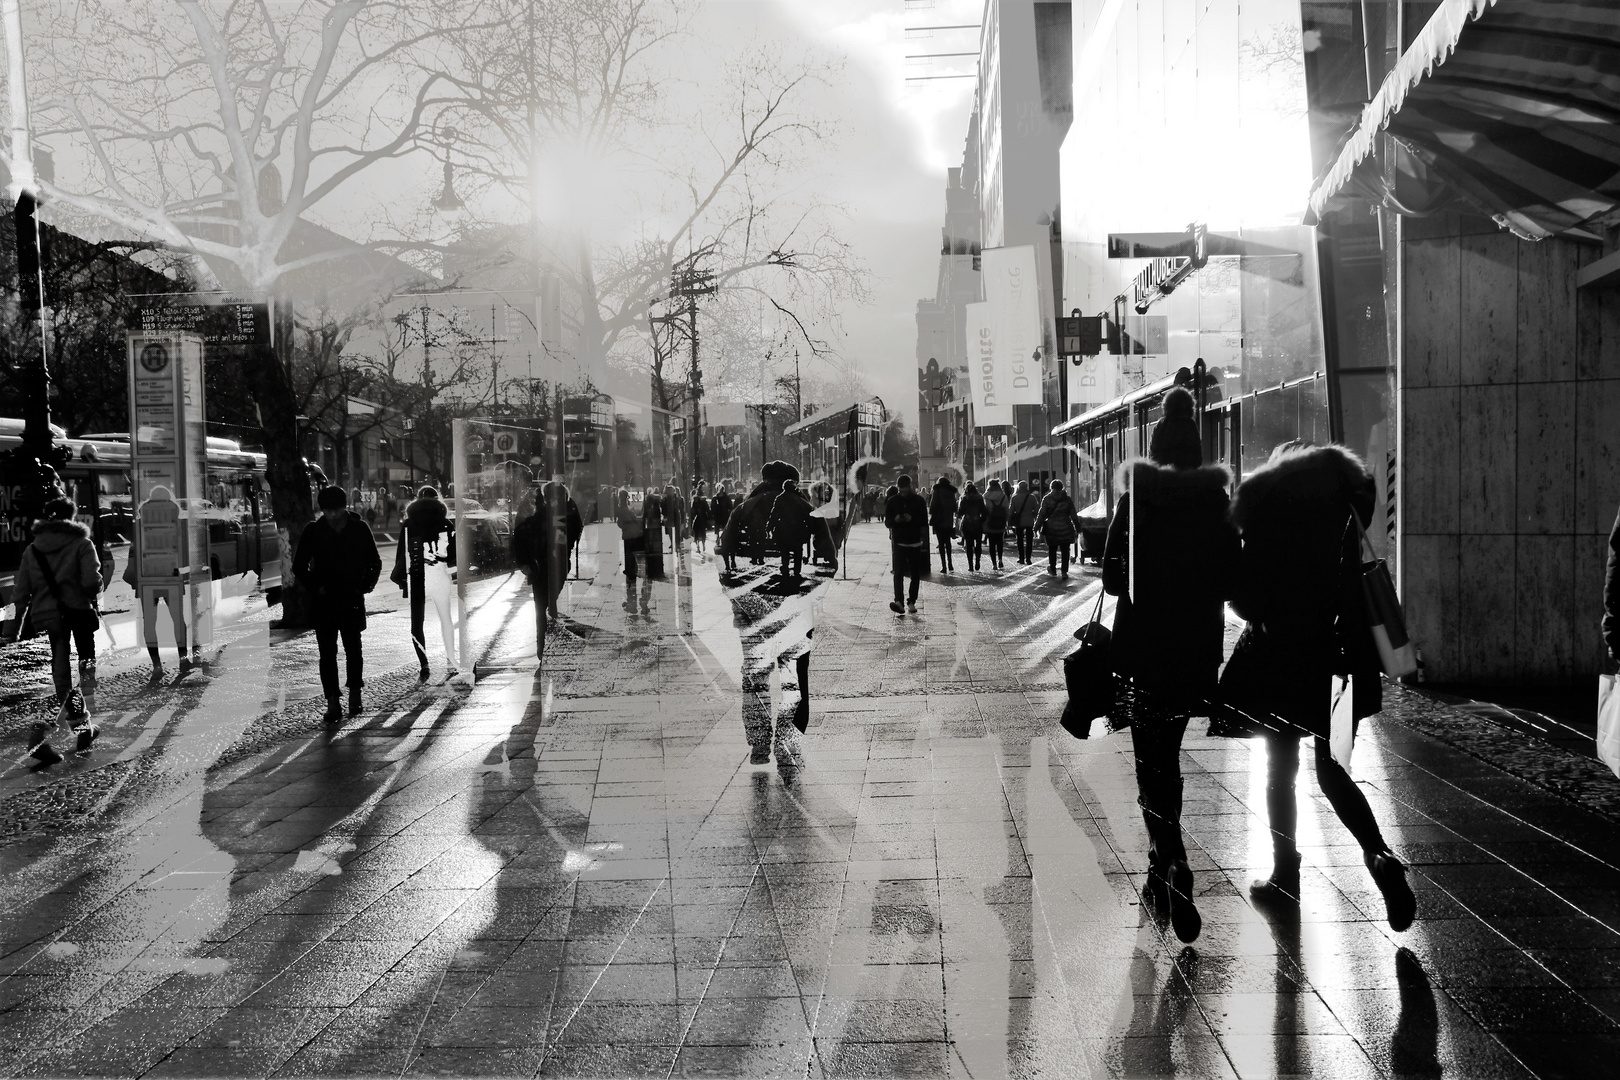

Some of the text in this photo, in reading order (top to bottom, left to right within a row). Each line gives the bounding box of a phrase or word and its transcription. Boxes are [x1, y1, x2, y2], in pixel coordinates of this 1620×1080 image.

[141, 308, 155, 316] X10
[241, 304, 254, 312] min
[142, 315, 155, 323] 109
[236, 312, 242, 320] 5
[142, 322, 156, 330] M19
[237, 319, 242, 327] 6
[242, 319, 255, 327] min
[504, 319, 510, 327] 6
[143, 329, 156, 337] M29
[232, 333, 248, 341] Infos
